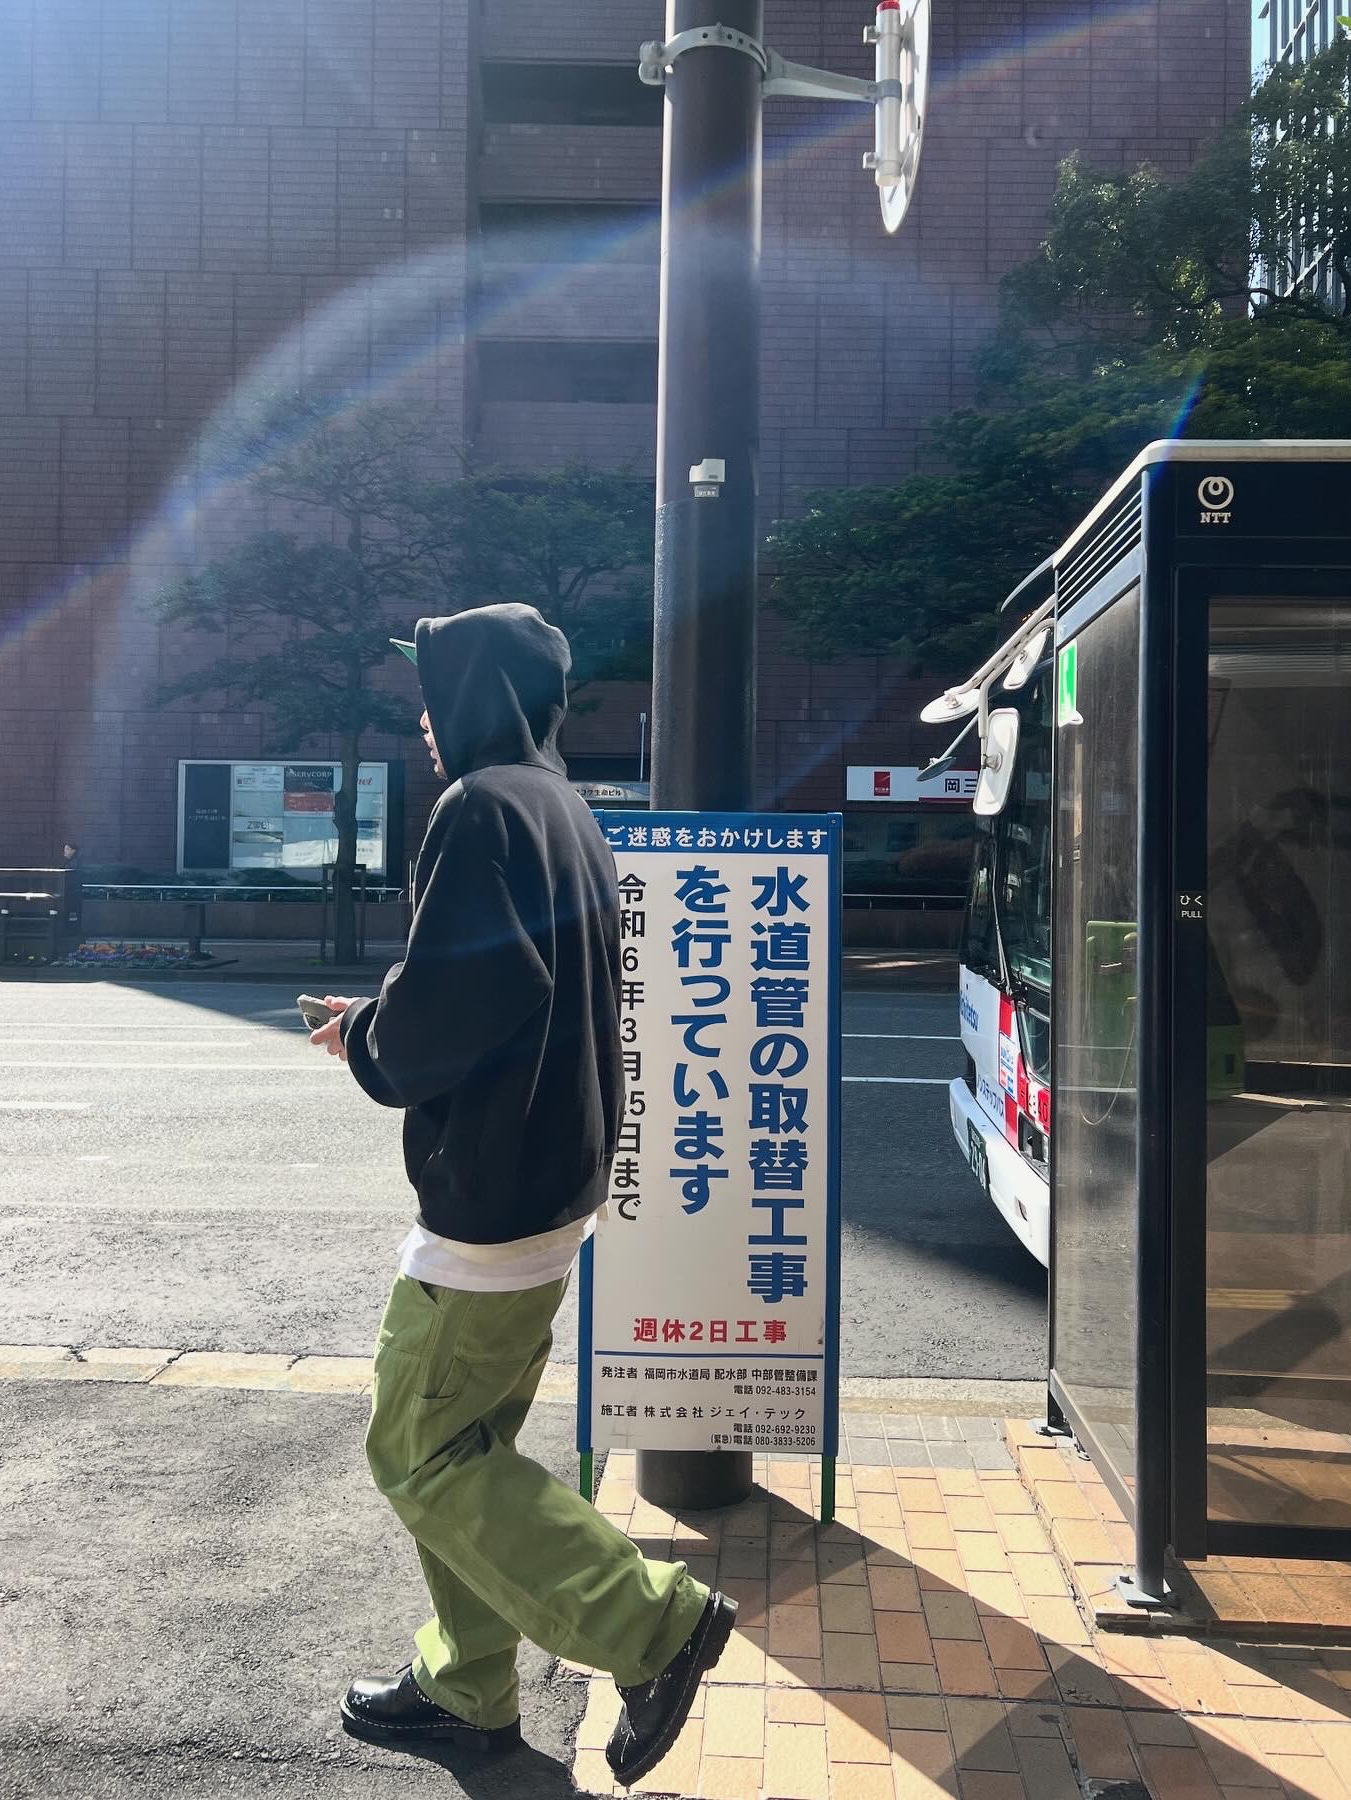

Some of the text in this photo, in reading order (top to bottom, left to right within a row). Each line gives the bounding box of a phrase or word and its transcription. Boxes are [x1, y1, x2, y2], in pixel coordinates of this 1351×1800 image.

[1200, 512, 1231, 523] NTT
[605, 826, 829, 850] ご迷惑をおかけします
[1180, 895, 1204, 906] ひく
[1181, 910, 1203, 919] PULL
[611, 873, 647, 1221] 令和6年3月5日まで
[669, 865, 732, 1216] を行っています
[747, 866, 811, 1304] 水道管の取替工事
[633, 1317, 788, 1344] 週休2日工事
[601, 1365, 819, 1382] 発注者 福岡市水道局 配水部 中部管整備課
[733, 1385, 817, 1396] 電話 092-483-3154
[600, 1404, 638, 1417] 施工者
[733, 1423, 817, 1434] 電話 092-692-9230
[755, 1436, 817, 1446] 080-3833-5206
